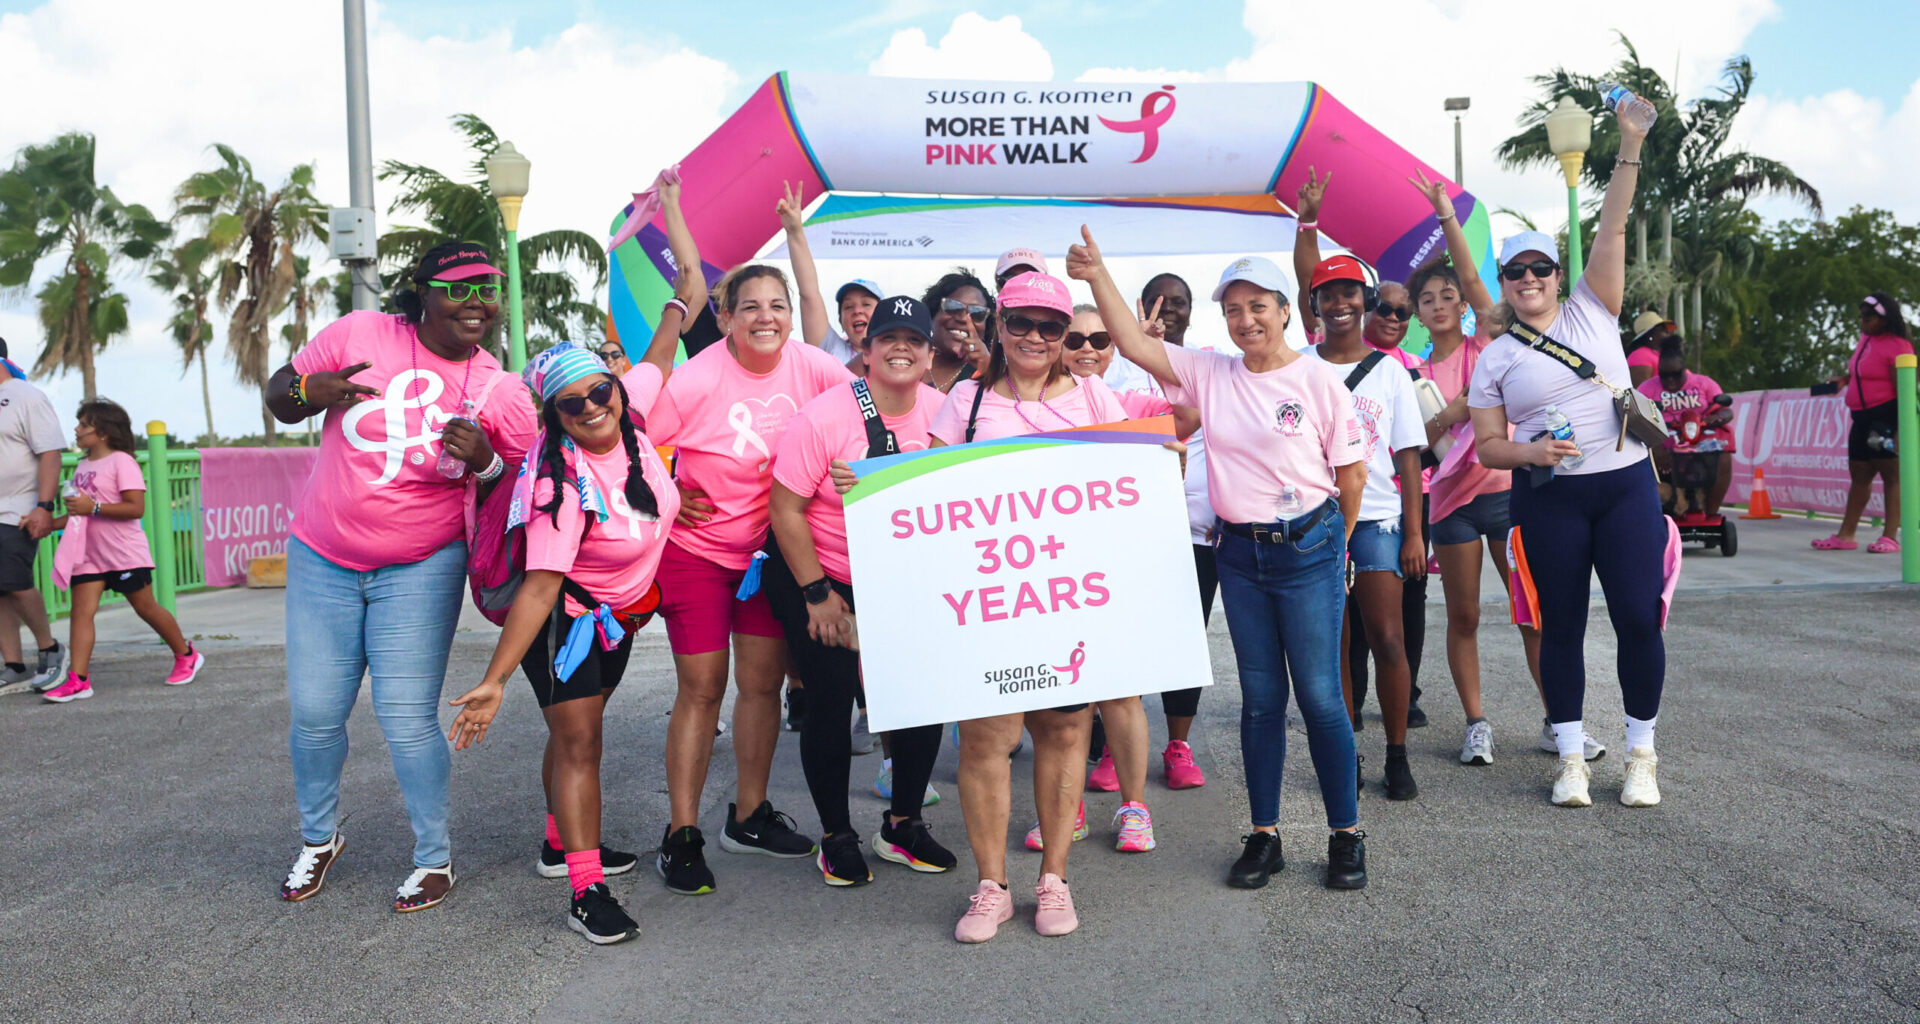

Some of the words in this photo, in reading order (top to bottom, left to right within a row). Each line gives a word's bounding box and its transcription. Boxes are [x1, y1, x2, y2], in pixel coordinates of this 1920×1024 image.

[926, 117, 1005, 137] MORE
[1011, 115, 1089, 136] THAN
[926, 144, 997, 165] PINK
[1002, 142, 1088, 165] WALK
[831, 238, 856, 246] BANK
[858, 238, 870, 246] OF
[872, 239, 914, 247] AMERICA
[1662, 396, 1702, 411] PINK
[890, 476, 1140, 539] SURVIVORS
[975, 534, 1065, 574] 30+
[942, 572, 1110, 626] YEARS
